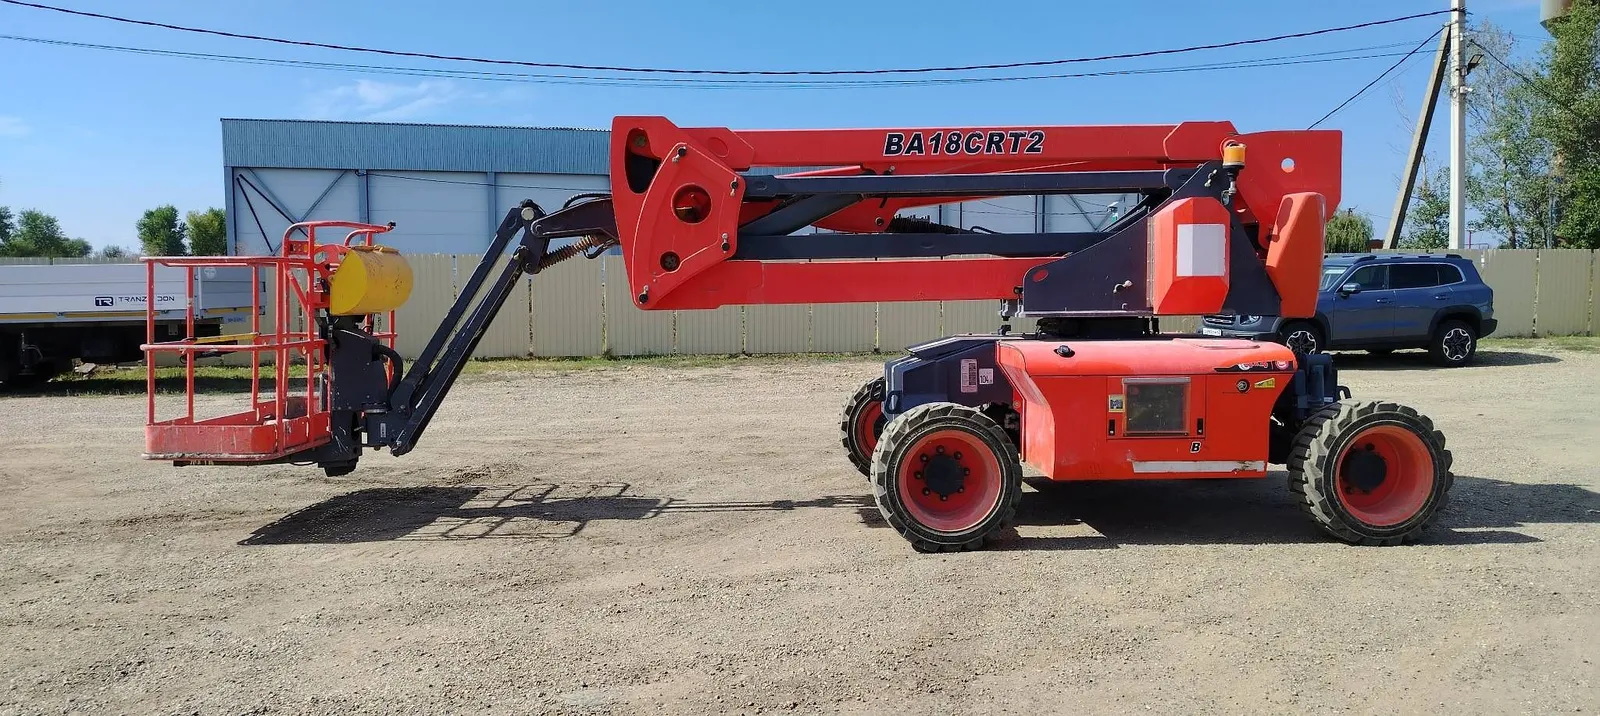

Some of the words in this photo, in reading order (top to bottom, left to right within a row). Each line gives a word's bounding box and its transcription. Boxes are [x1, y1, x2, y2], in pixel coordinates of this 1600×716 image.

[884, 130, 1045, 156] BA18CRT2
[95, 297, 113, 306] TR
[1190, 441, 1201, 453] B
